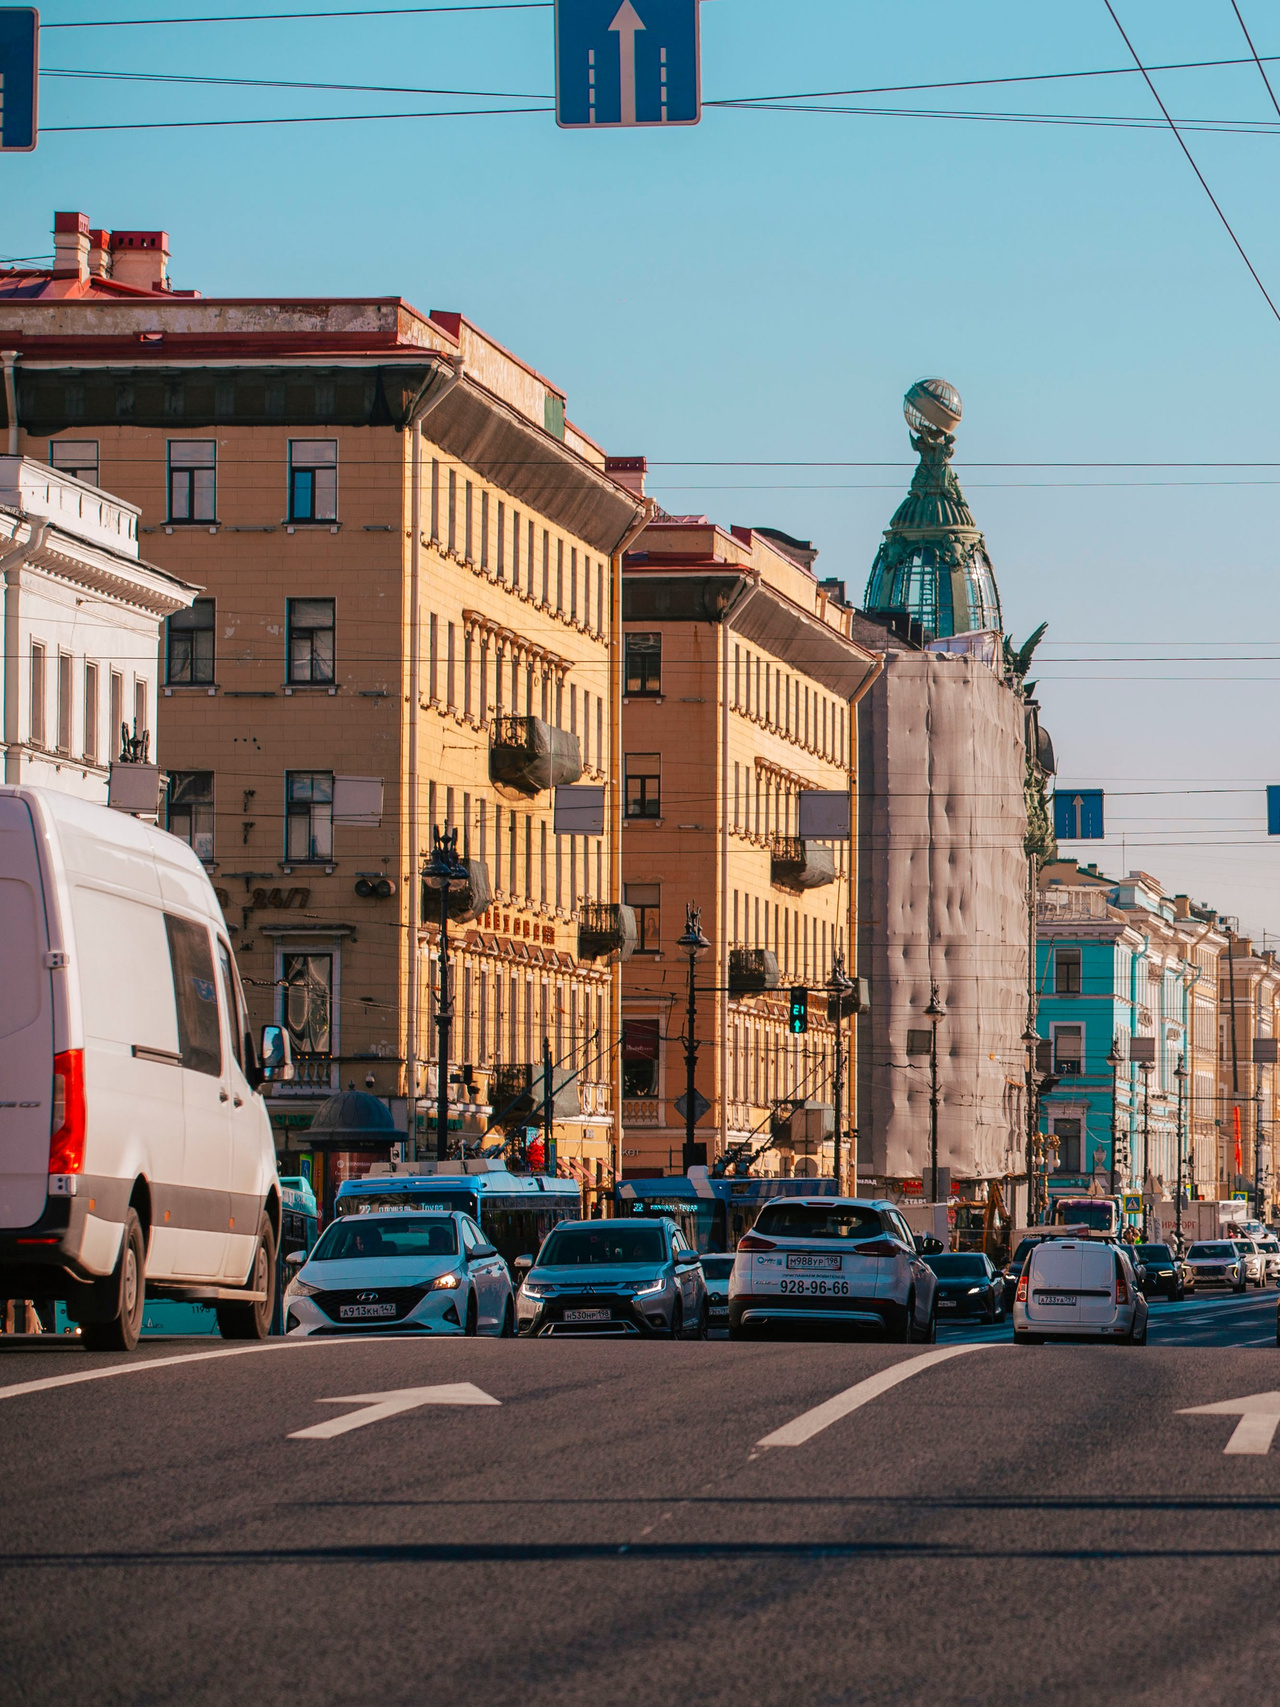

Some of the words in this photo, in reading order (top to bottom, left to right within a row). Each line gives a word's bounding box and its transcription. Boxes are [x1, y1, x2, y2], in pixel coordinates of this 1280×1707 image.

[252, 887, 311, 908] 24/7
[633, 1203, 644, 1212] 22
[1161, 1221, 1197, 1230] ИРАОРГ
[790, 1256, 824, 1266] М988УР
[826, 1256, 839, 1264] 198
[780, 1280, 849, 1294] 928-96-66
[342, 1306, 379, 1317] А913КН
[380, 1304, 393, 1312] 147
